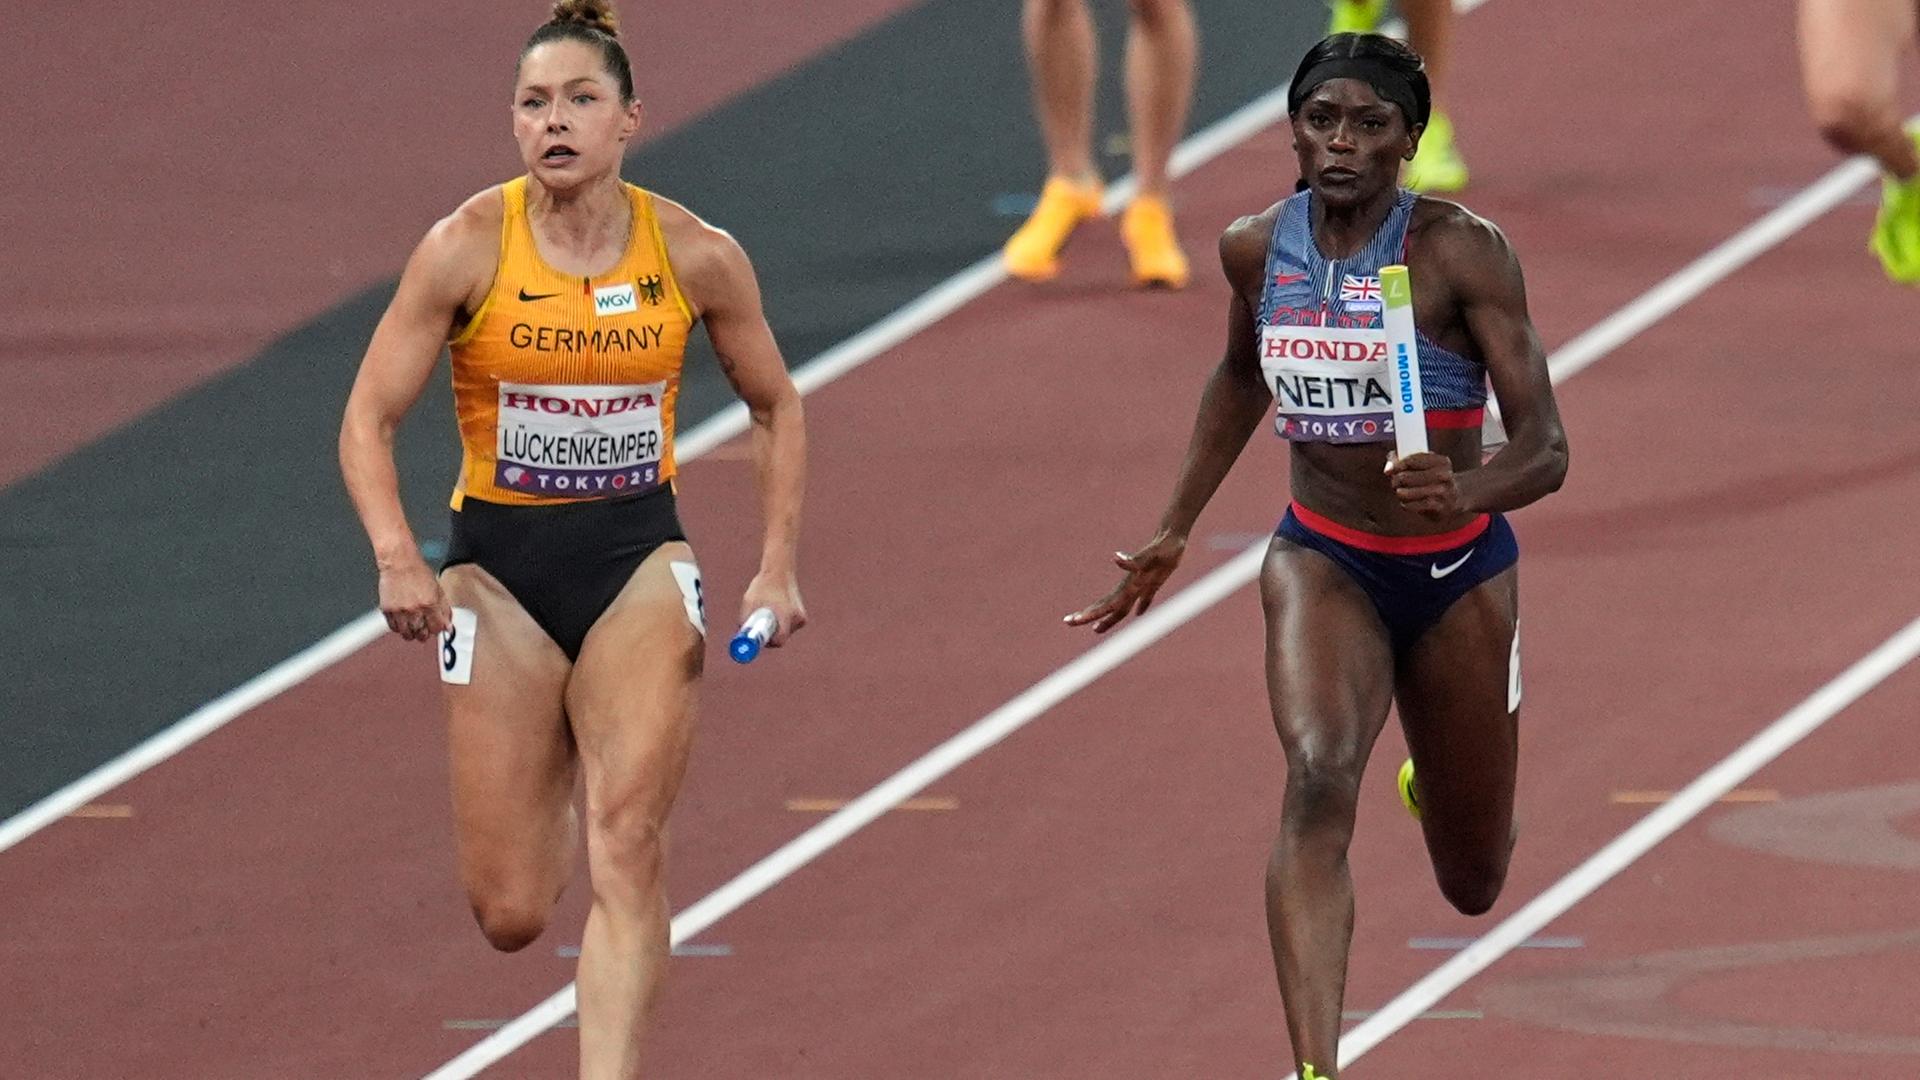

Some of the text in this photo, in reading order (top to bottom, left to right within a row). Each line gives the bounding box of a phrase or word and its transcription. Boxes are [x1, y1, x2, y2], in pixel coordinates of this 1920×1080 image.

[596, 291, 633, 309] WGV
[510, 323, 664, 352] GERMANY
[1265, 338, 1389, 361] HONDA
[1276, 375, 1392, 409] NEITA
[1397, 354, 1414, 414] MONDO
[503, 391, 656, 418] HONDA
[503, 424, 658, 466] LÜCKENKEMPER
